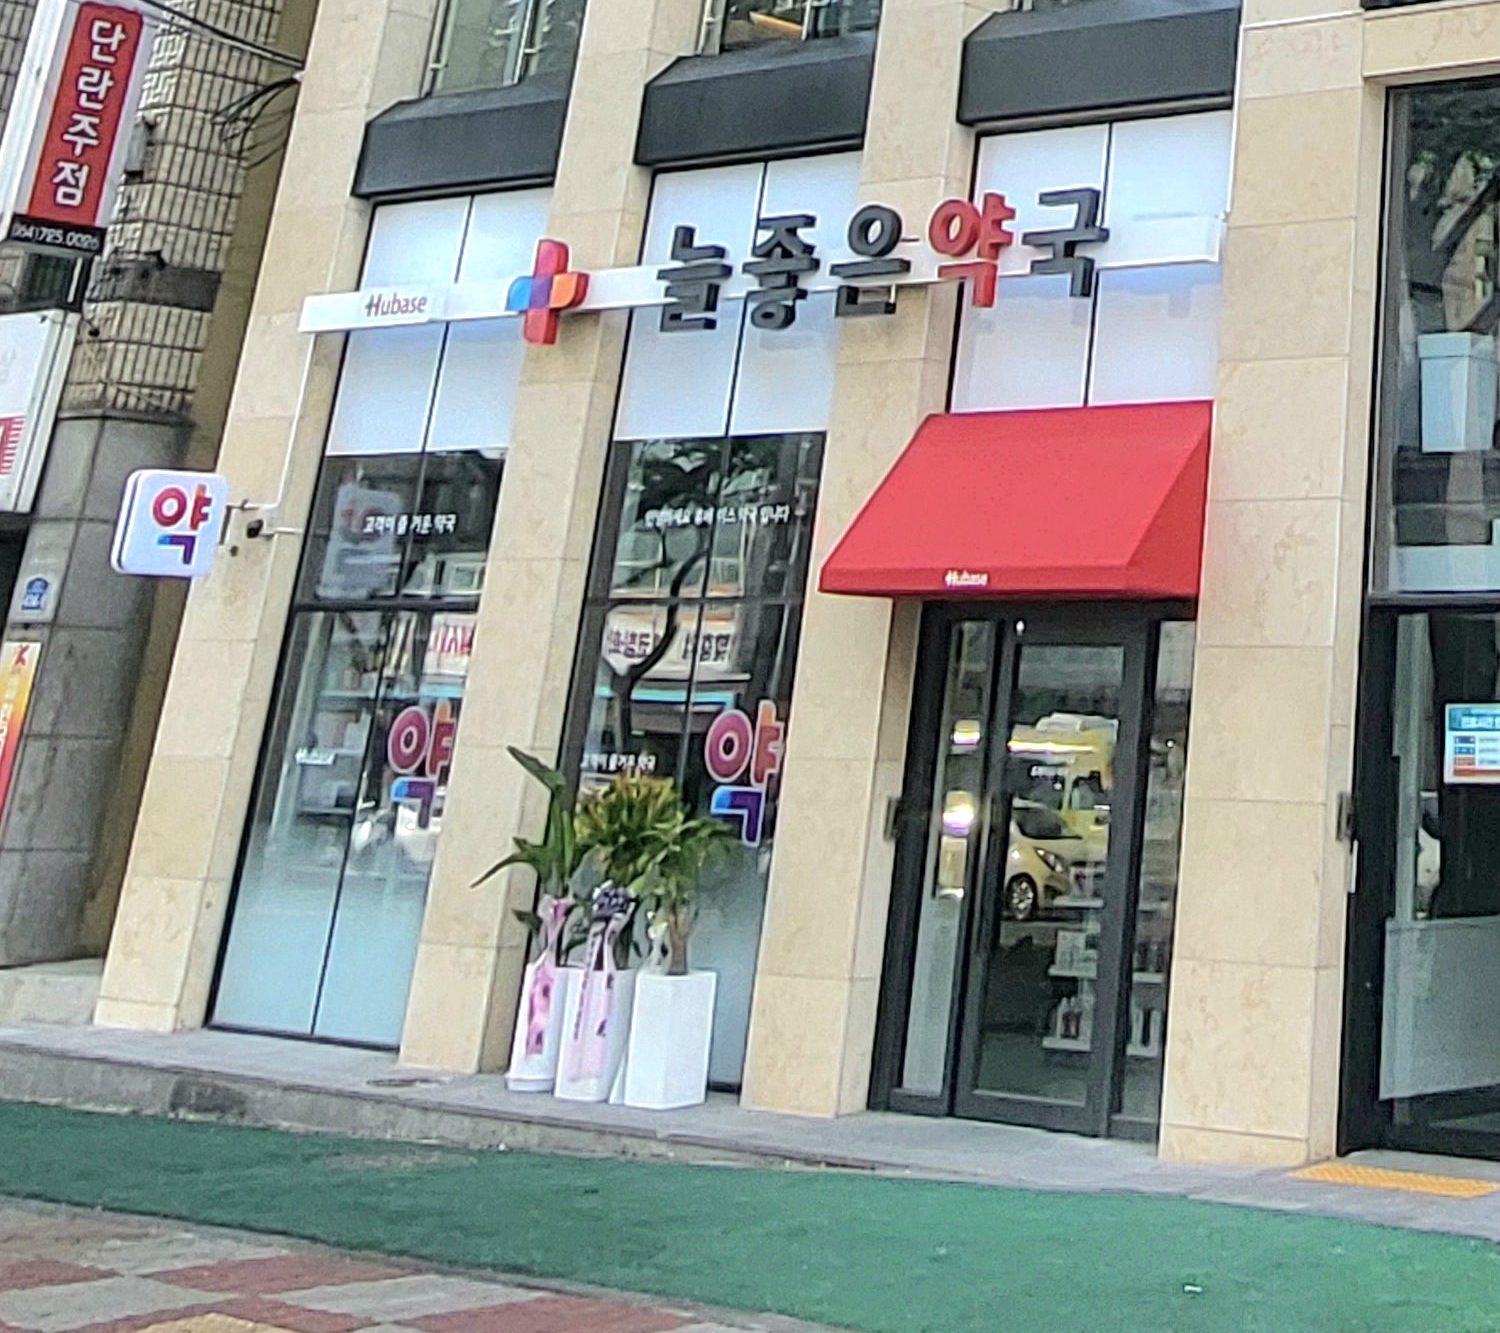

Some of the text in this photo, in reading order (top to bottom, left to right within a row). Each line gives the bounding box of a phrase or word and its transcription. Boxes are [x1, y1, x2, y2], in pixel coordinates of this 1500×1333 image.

[53, 19, 126, 207] 단란주점
[364, 292, 427, 318] Hubase
[657, 188, 1110, 333] 늘좋은약국
[152, 484, 213, 565] 약
[388, 699, 456, 829] 약
[705, 700, 784, 847] 약
